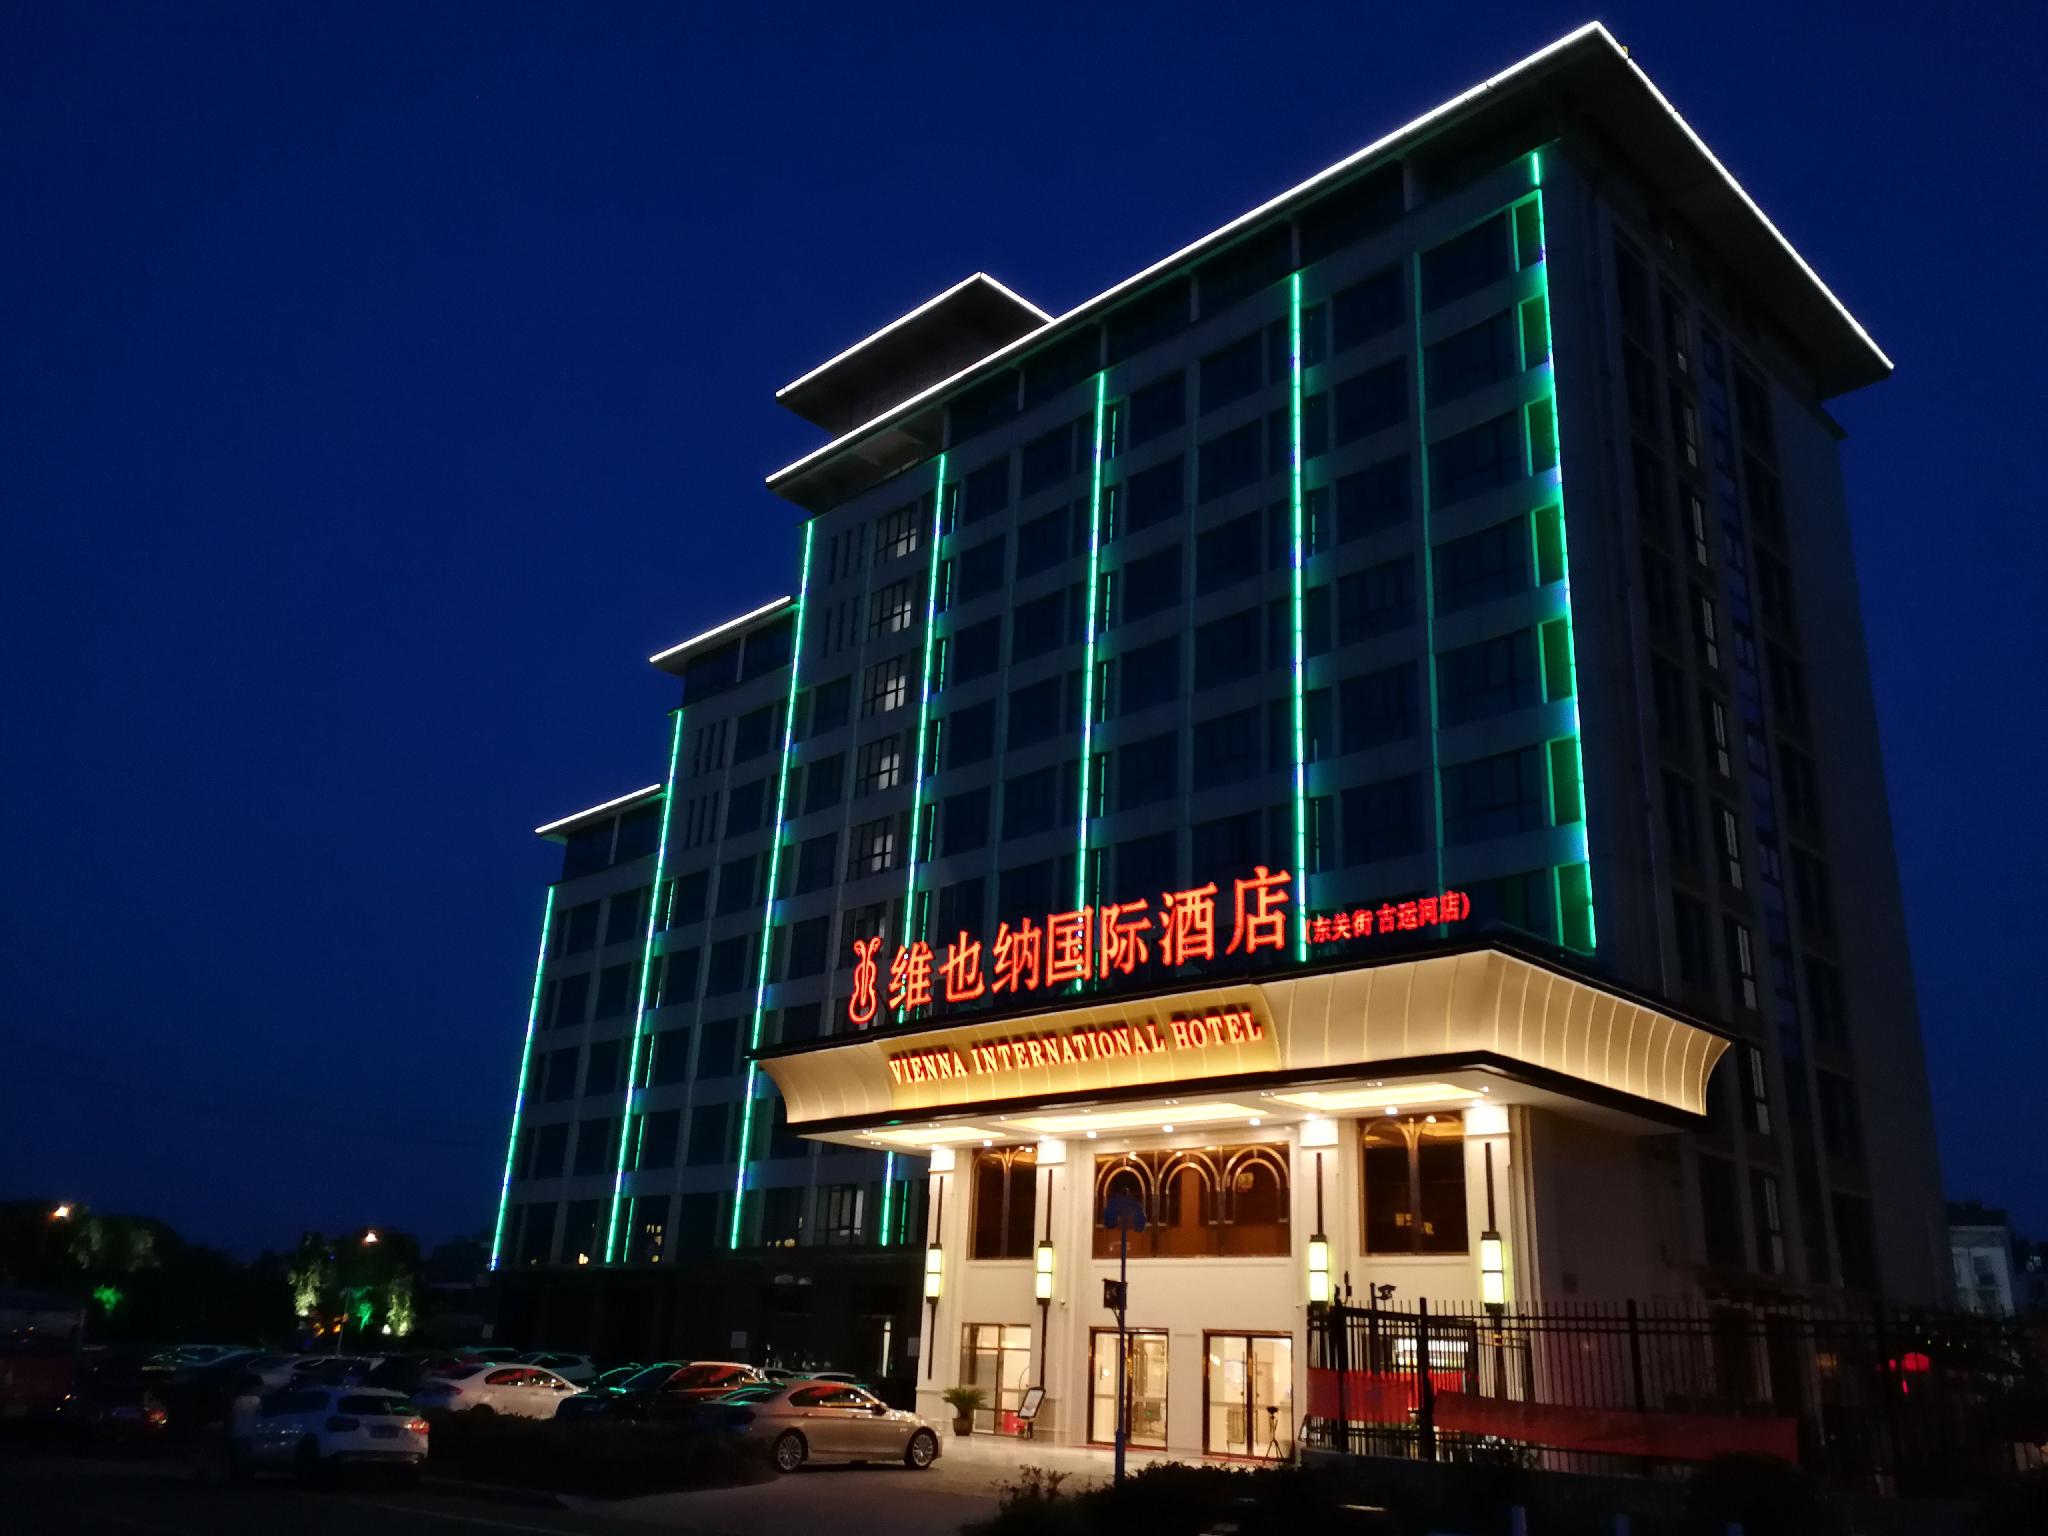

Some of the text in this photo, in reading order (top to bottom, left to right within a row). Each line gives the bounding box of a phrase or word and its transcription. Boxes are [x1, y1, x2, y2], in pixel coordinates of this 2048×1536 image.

[889, 865, 1292, 1012] 维也纳国际酒店
[889, 1011, 1263, 1085] VIENNA INTERNATIONAL HOTEL
